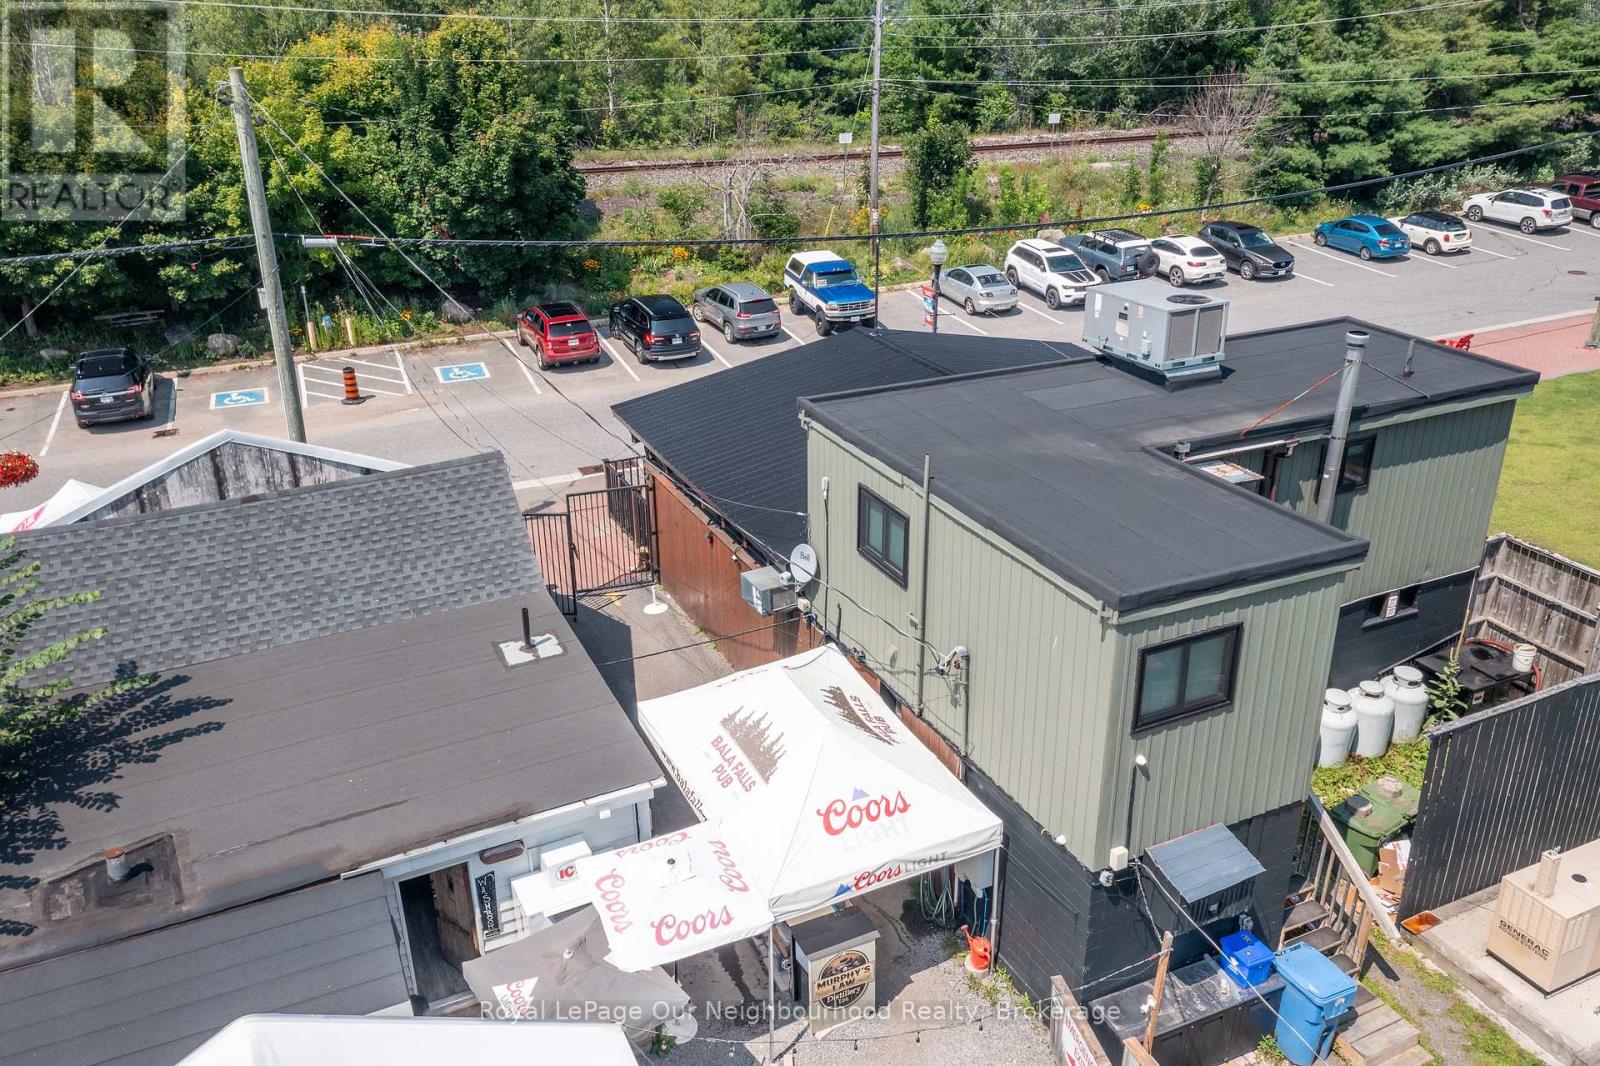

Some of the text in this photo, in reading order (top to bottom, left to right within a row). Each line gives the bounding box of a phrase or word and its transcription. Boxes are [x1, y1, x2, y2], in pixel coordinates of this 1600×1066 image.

[710, 734, 757, 793] BALA FALLS
[711, 763, 734, 789] PUB
[816, 790, 912, 837] Coors
[614, 831, 692, 859] Coors
[708, 839, 750, 893] Coors
[854, 851, 948, 891] Coors LIGHT
[594, 867, 634, 935] Coors
[650, 905, 735, 947] Coors
[1500, 919, 1550, 957] GENERAC
[817, 965, 871, 990] MURPHY'S
[832, 978, 856, 990] LAW
